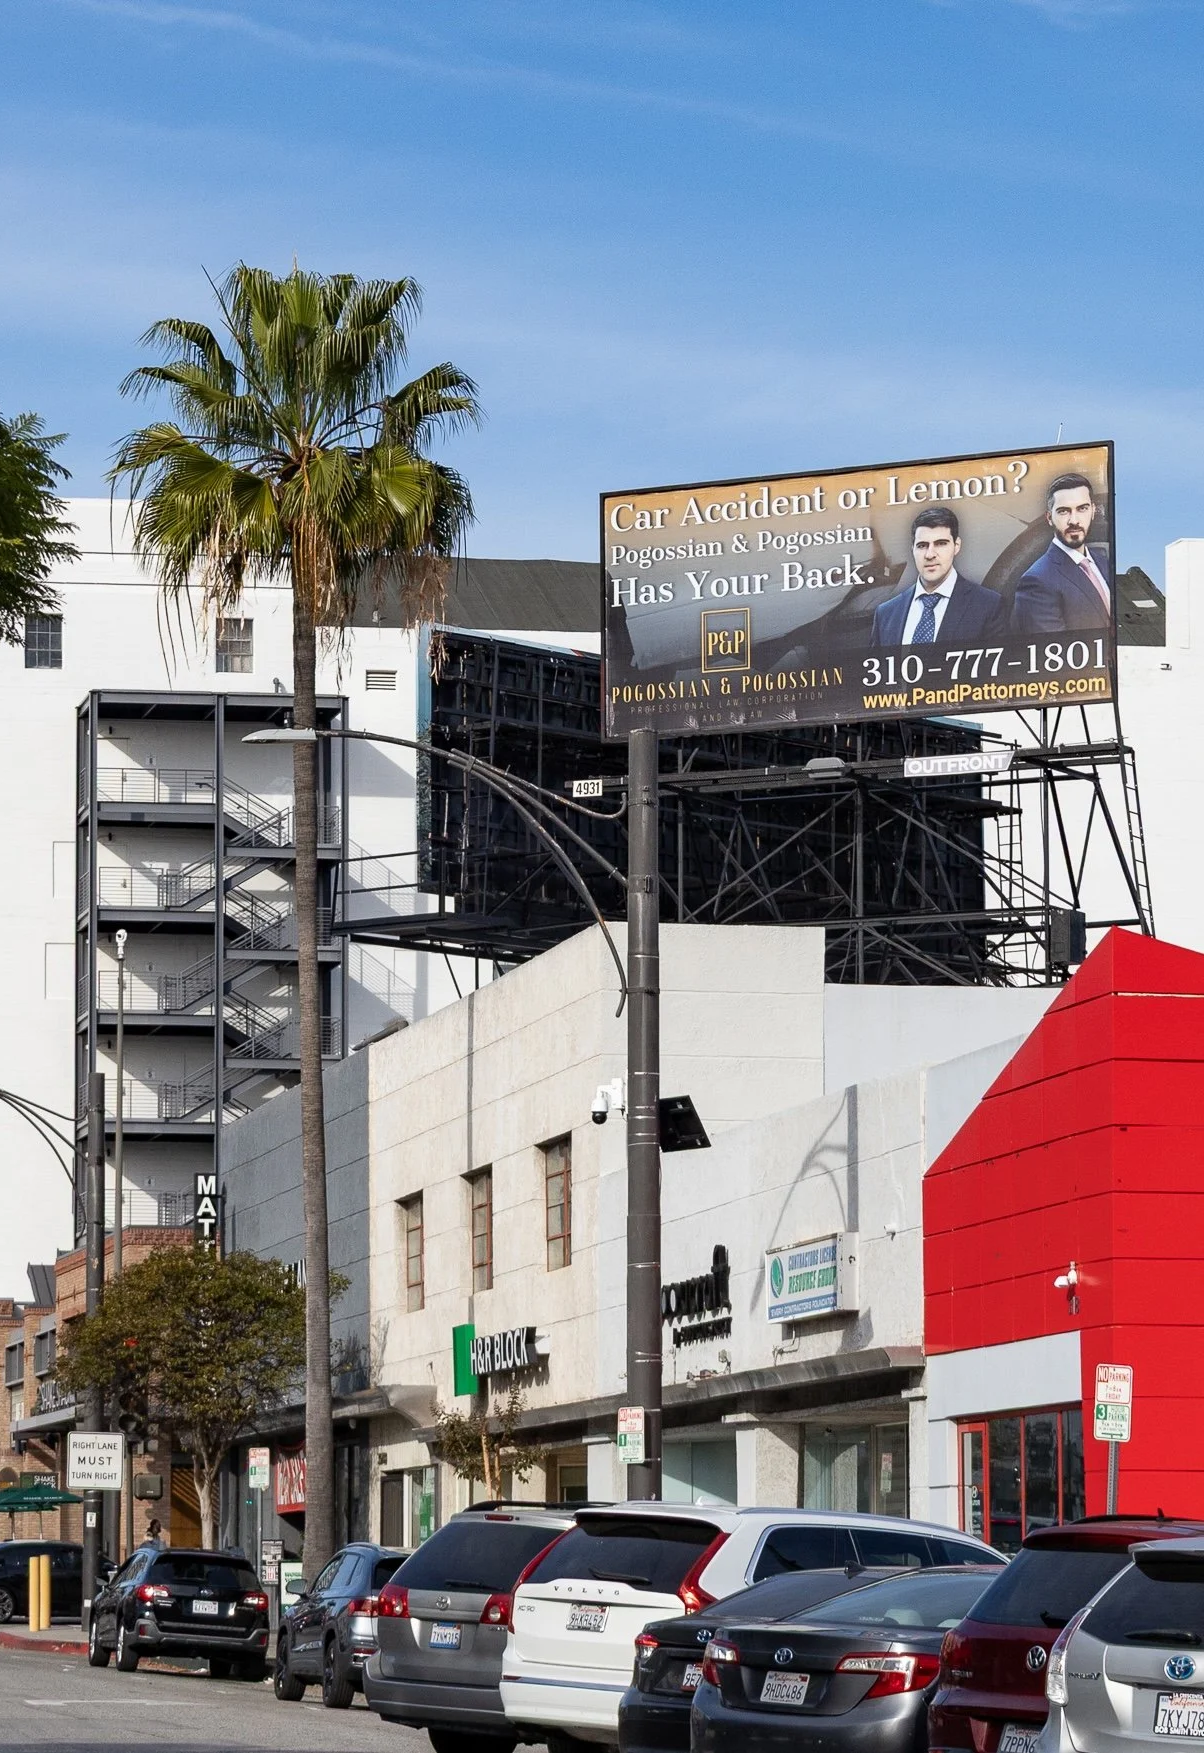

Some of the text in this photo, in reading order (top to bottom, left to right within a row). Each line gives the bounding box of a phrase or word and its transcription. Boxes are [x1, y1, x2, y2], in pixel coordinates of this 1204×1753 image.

[610, 460, 1028, 533] Car Accident or Lemon?
[611, 524, 873, 569] Pogossian & Pogossian
[610, 553, 875, 608] Has Your Back.
[707, 629, 746, 656] P&P
[862, 638, 1107, 687] 310-777-1801
[612, 667, 844, 704] POGOSSIAN & POGOSSIAN
[863, 675, 1107, 709] www.PandPattorneys.com
[630, 691, 824, 714] PROFESSIONAL LAW CORPORATION
[908, 753, 1008, 775] OUTFRONT
[576, 781, 600, 795] 4931
[470, 1327, 528, 1376] H&R BLOCK
[1098, 1367, 1108, 1381] NO
[1098, 1404, 1106, 1419] 3
[97, 1442, 118, 1450] LANE
[77, 1456, 113, 1466] MUST
[71, 1471, 118, 1480] TURN RIGHT
[554, 1585, 620, 1596] VOLVO
[764, 1683, 805, 1700] 9HDC486
[1160, 1709, 1204, 1730] 7KYJ78
